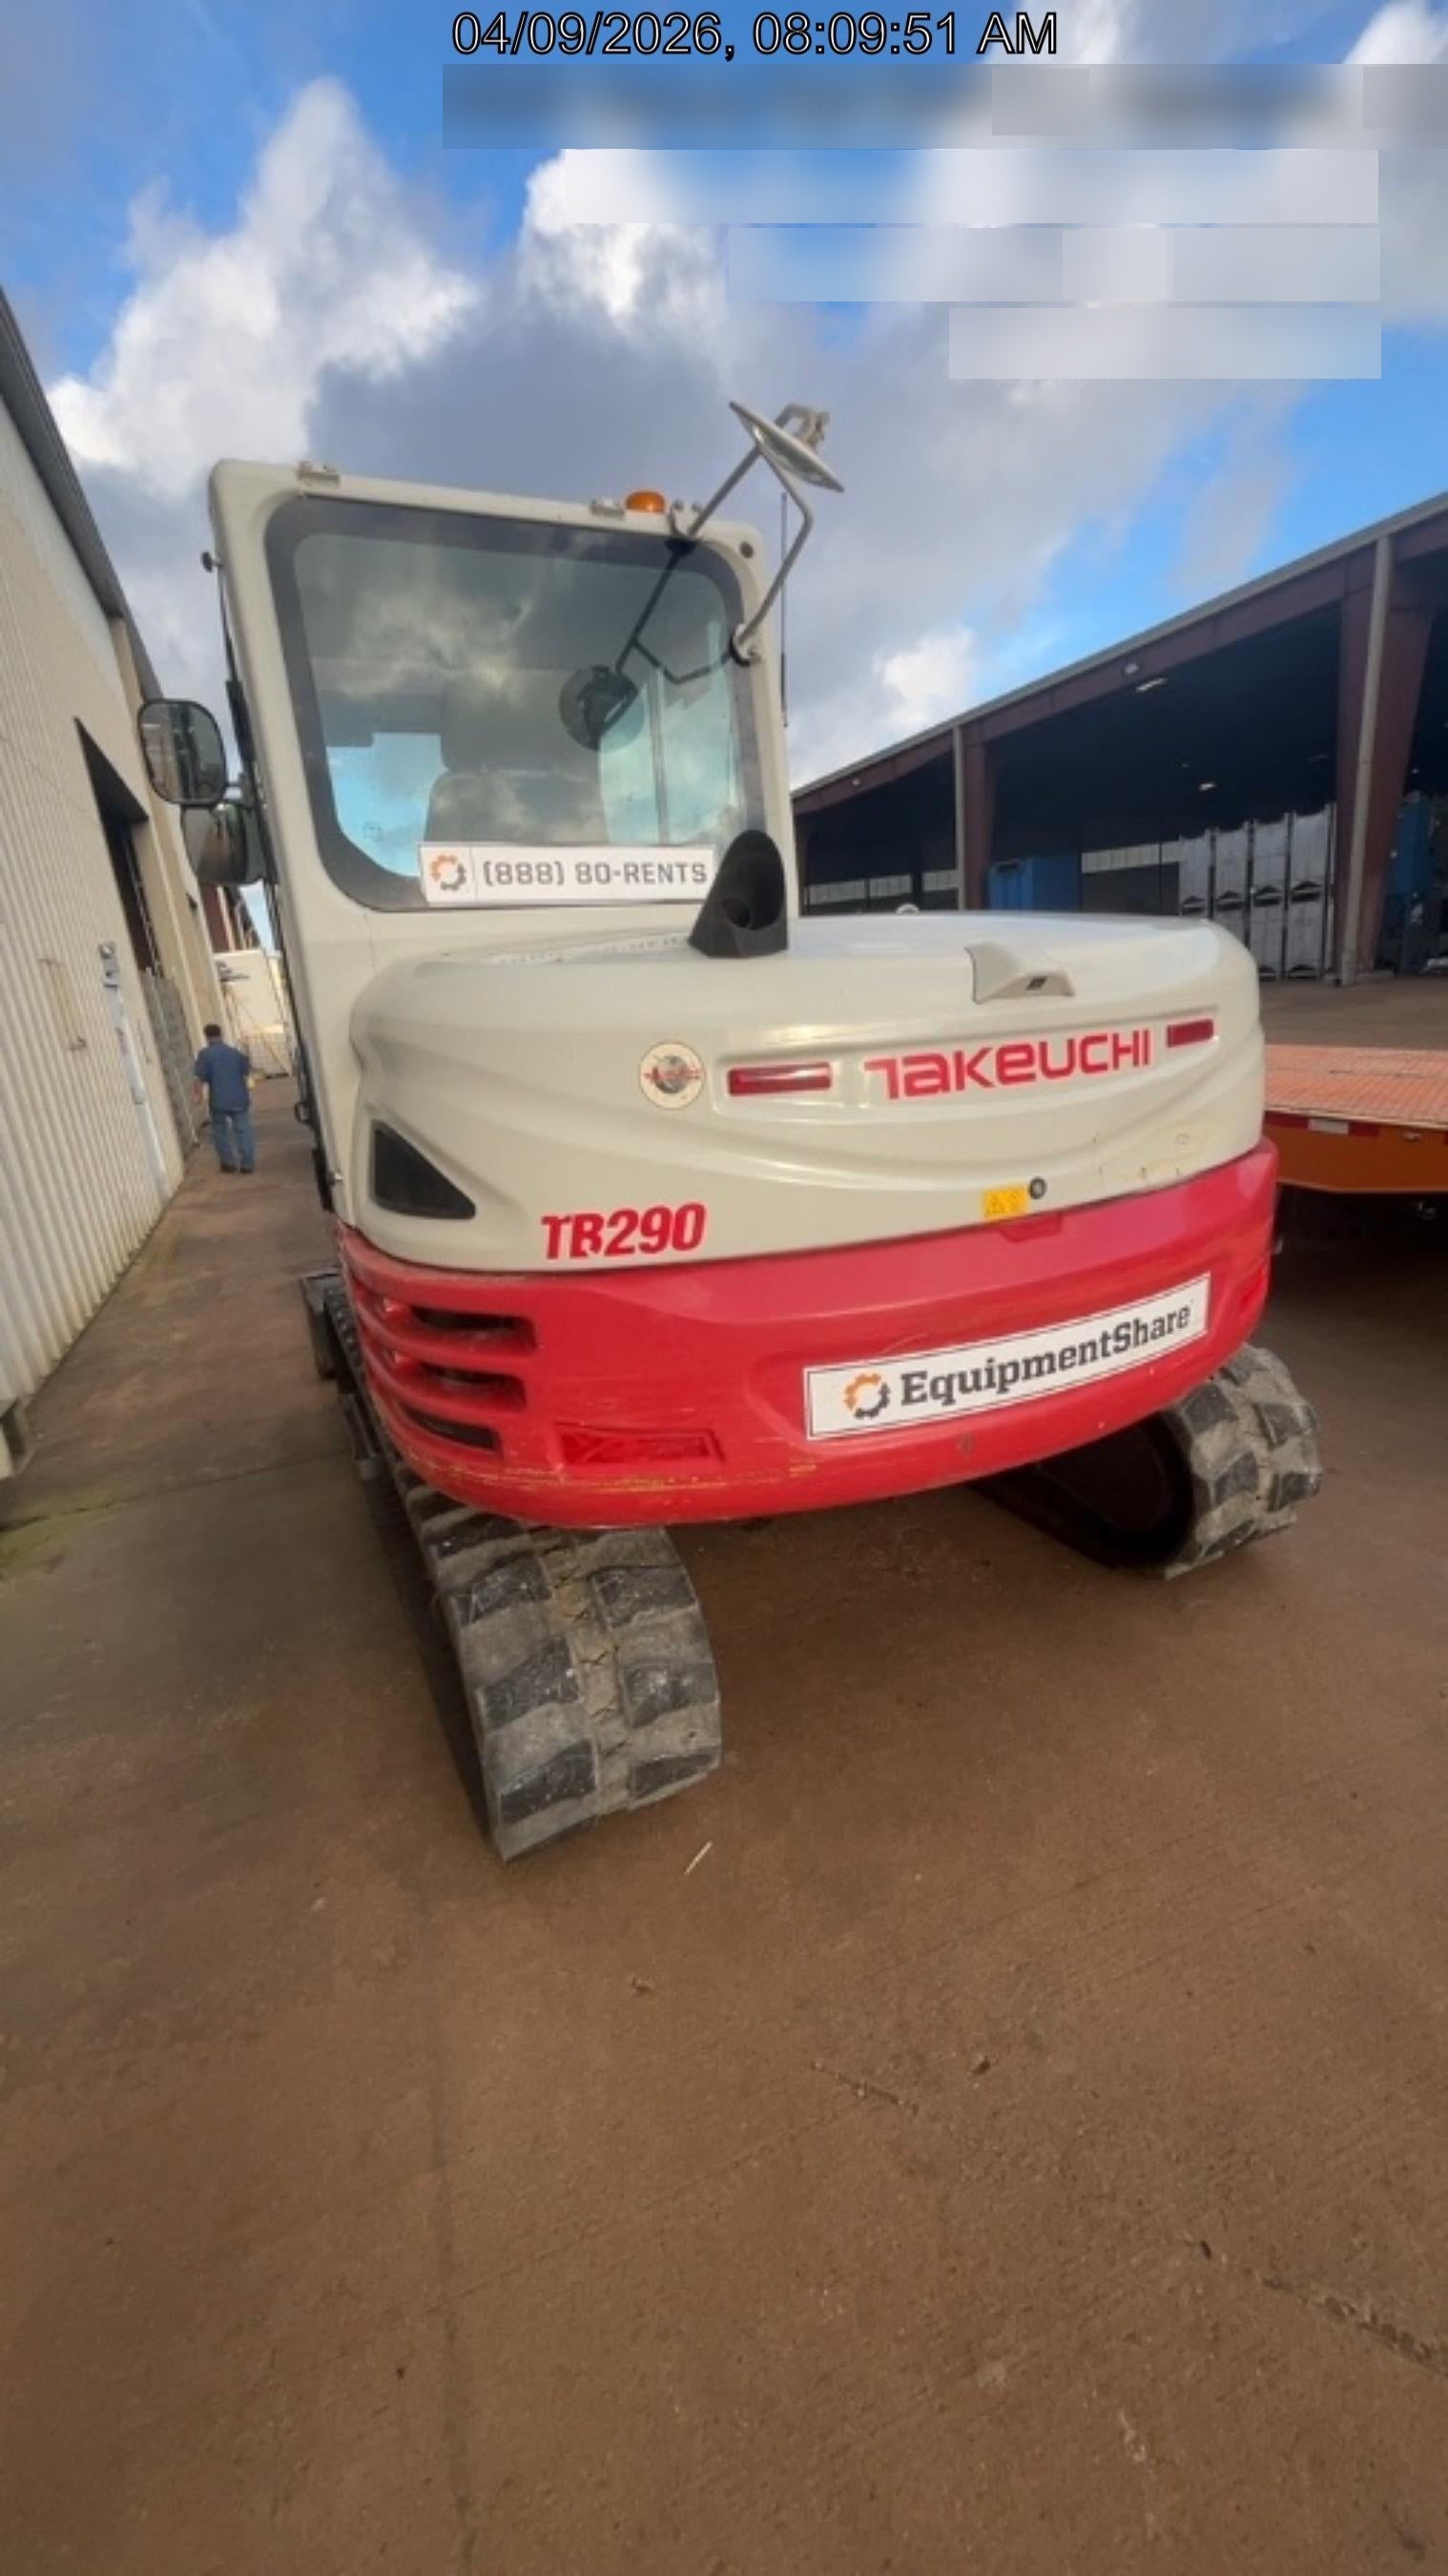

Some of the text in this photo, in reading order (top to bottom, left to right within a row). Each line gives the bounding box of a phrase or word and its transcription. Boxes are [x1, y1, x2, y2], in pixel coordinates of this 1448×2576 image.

[484, 861, 708, 886] (888) 80-RENTS
[541, 1202, 707, 1260] TB290
[900, 1304, 1191, 1407] EquipmentShare
